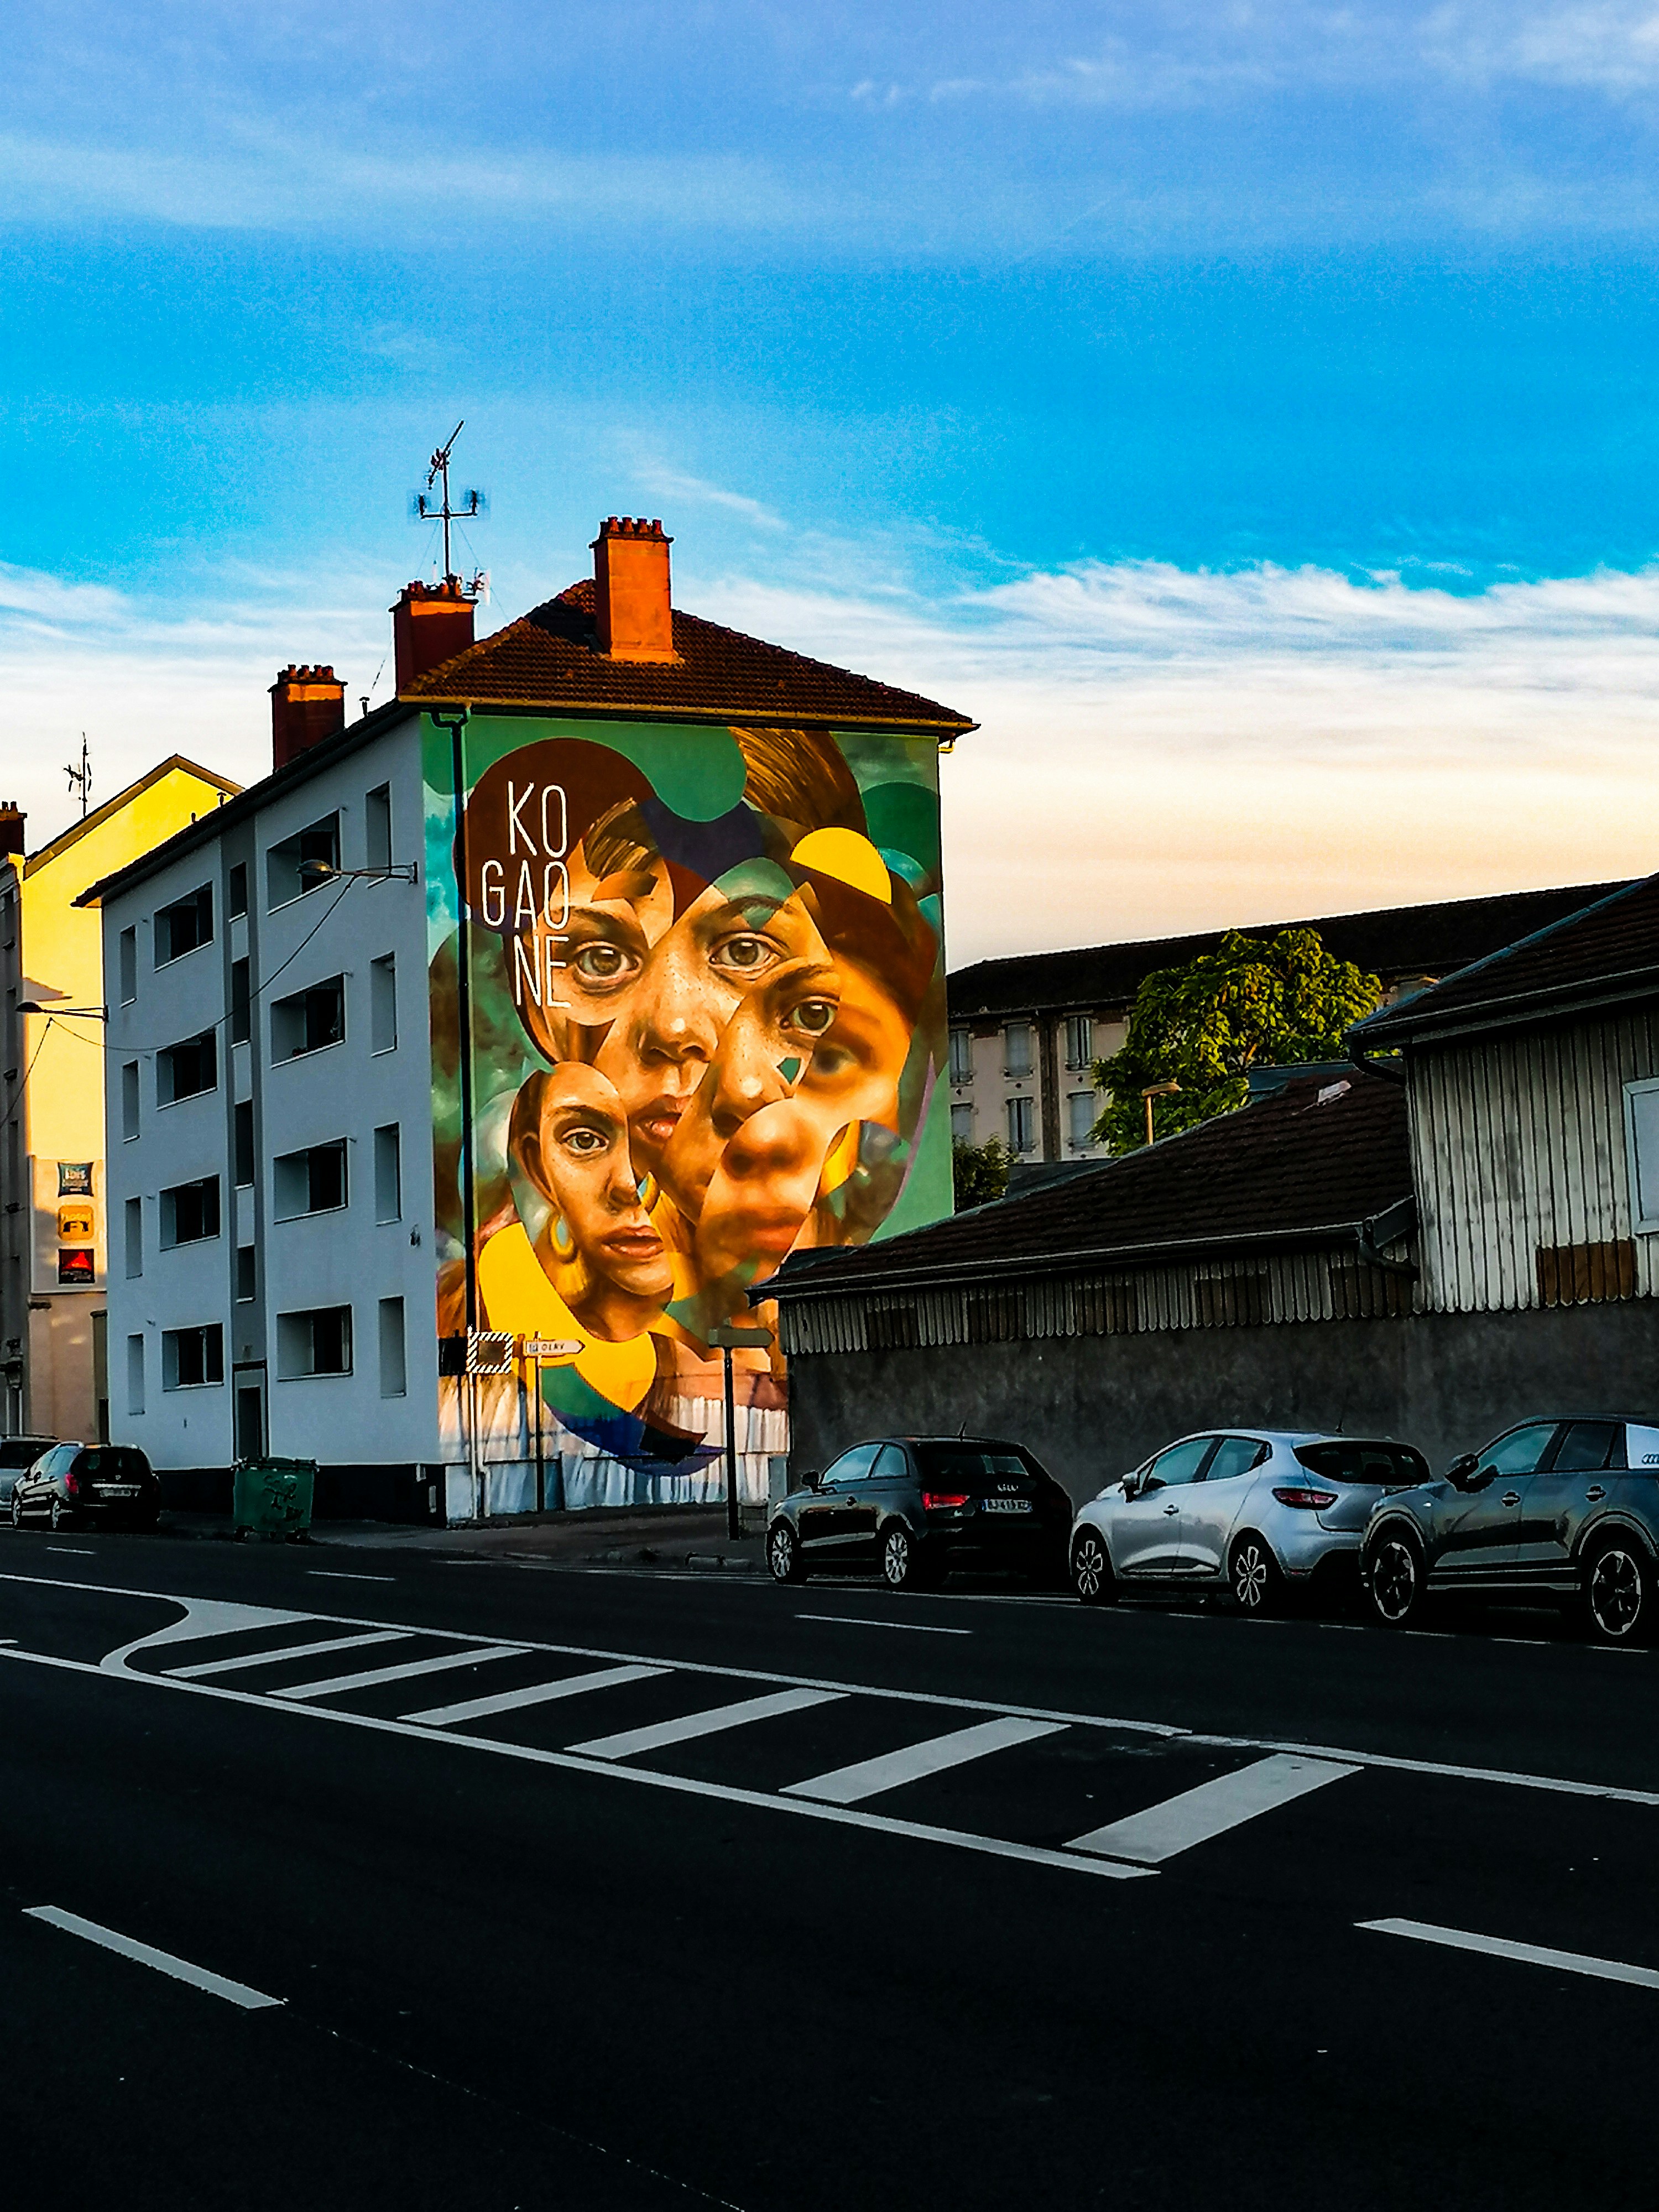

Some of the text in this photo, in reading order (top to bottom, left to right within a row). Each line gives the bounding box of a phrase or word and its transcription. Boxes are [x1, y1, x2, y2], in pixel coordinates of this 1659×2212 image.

[507, 780, 568, 858] KO
[481, 859, 570, 930] GAO
[513, 935, 572, 1009] NE
